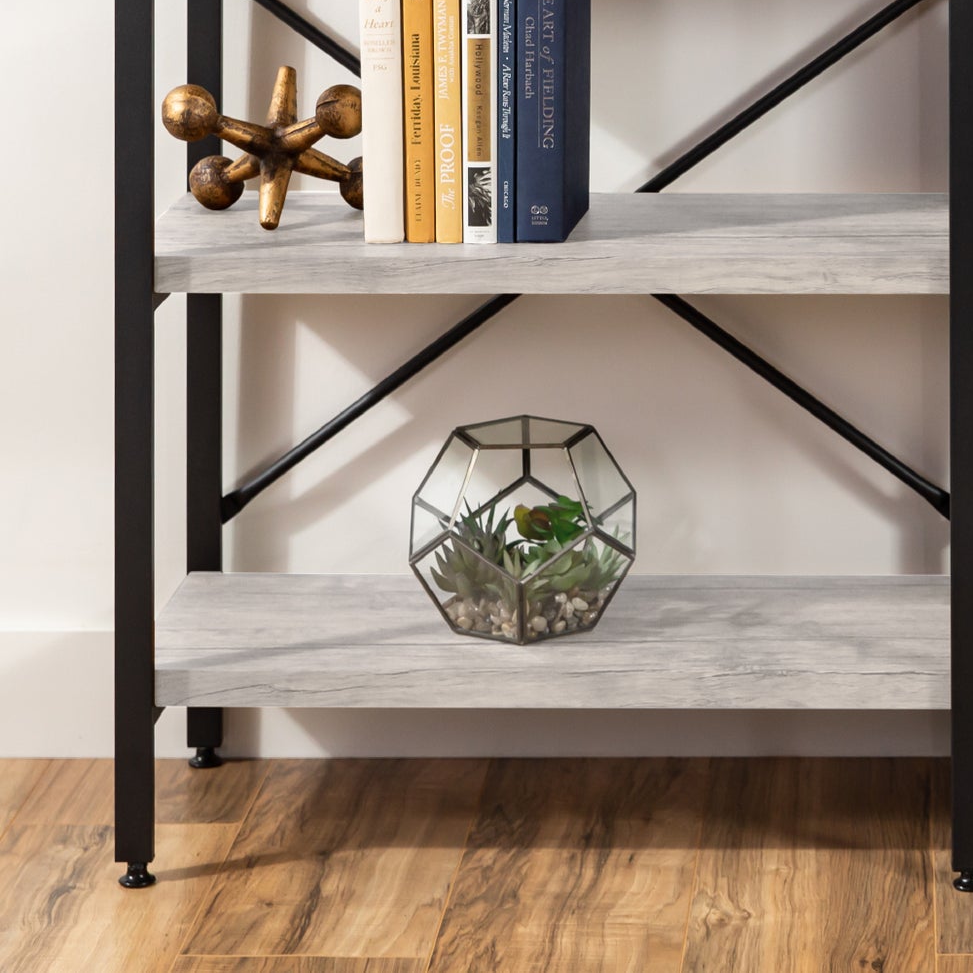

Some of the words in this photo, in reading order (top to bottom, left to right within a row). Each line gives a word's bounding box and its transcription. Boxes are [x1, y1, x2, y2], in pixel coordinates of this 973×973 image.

[364, 18, 394, 29] Heart
[438, 0, 447, 51] TWYMAN
[525, 16, 536, 47] Chad
[542, 8, 555, 43] ART
[410, 33, 421, 90] Louisiana
[474, 43, 483, 96] Hollywood
[525, 50, 536, 99] Harbach
[539, 45, 555, 65] of
[438, 65, 449, 100] JAMES
[542, 68, 555, 149] FIELDING
[439, 123, 456, 184] PROOF
[440, 187, 456, 210] The
